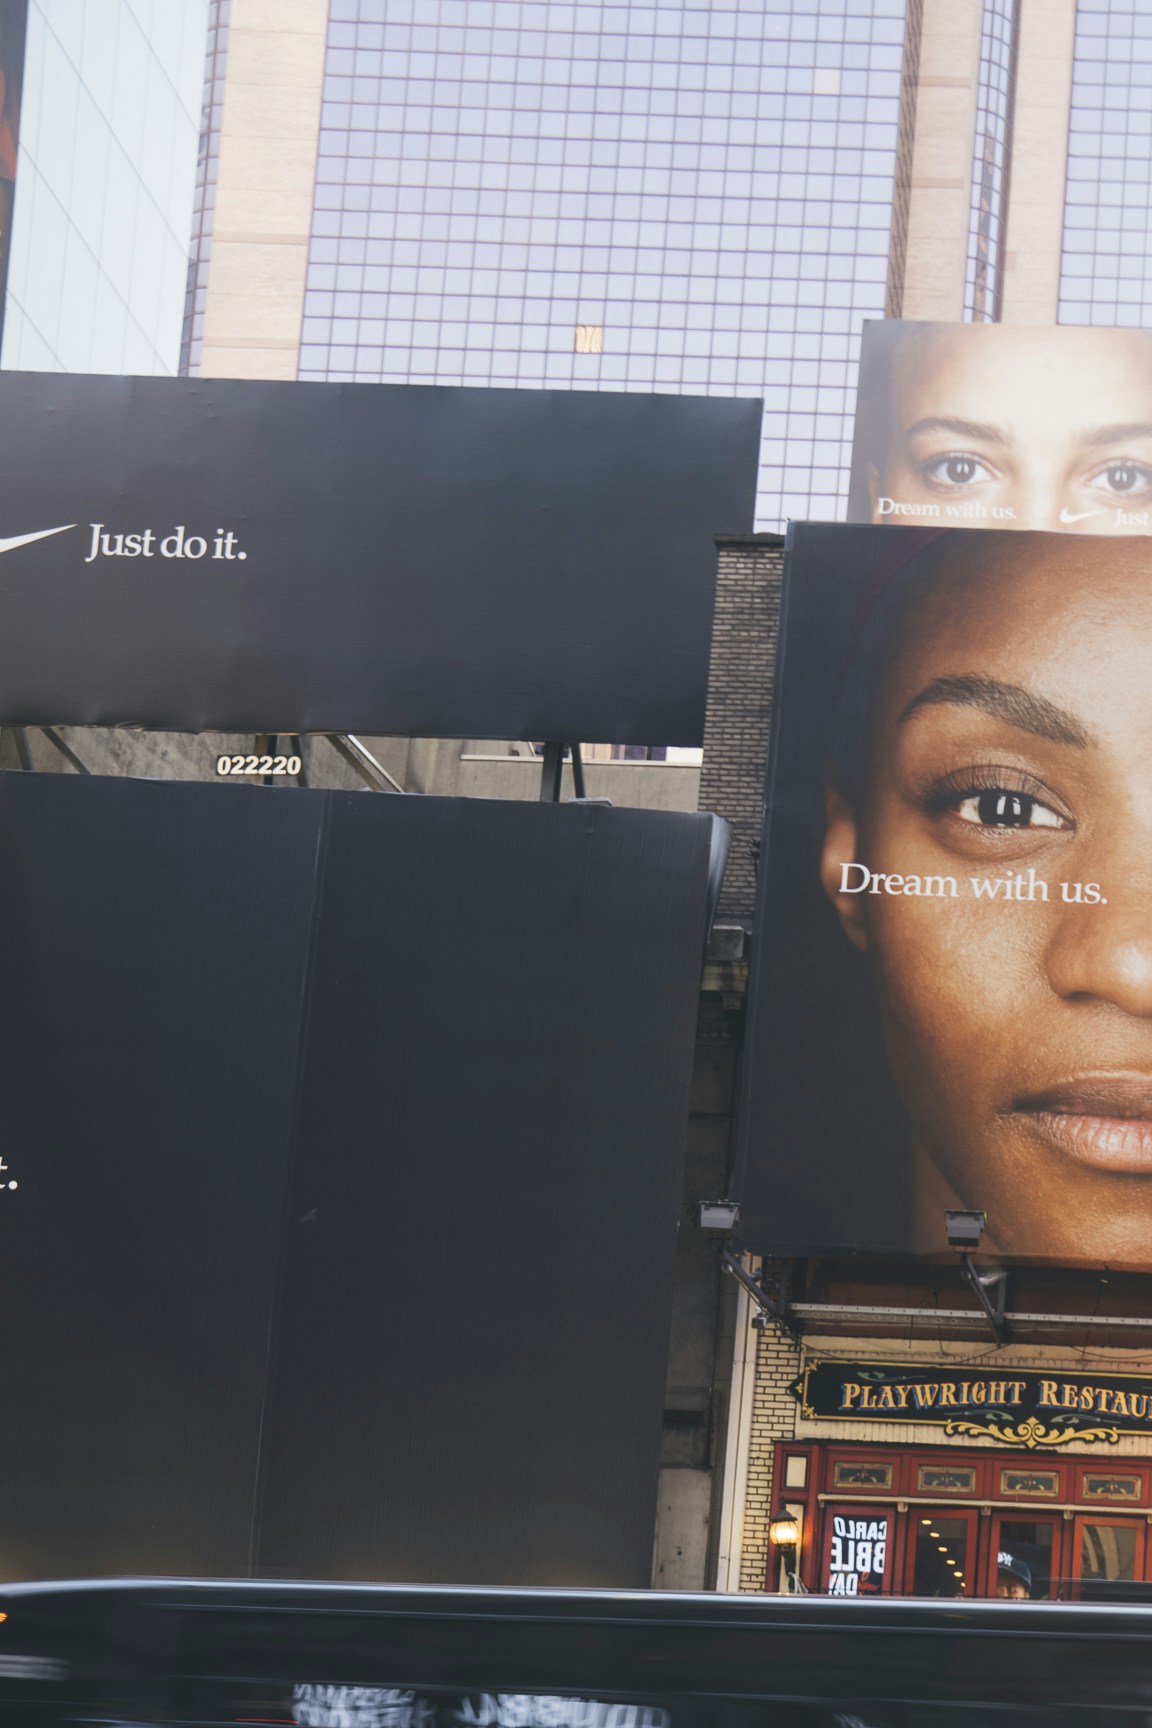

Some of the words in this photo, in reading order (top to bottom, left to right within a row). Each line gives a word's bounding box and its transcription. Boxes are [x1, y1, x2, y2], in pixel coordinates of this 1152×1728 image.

[877, 497, 940, 518] Dream
[945, 500, 987, 519] with
[991, 506, 1018, 521] us.
[1114, 508, 1151, 528] Just
[85, 523, 155, 563] Just
[160, 526, 207, 560] do
[211, 528, 248, 561] it.
[217, 755, 302, 775] 022220
[838, 863, 959, 899] Dream
[968, 866, 1049, 903] with
[1060, 878, 1108, 906] us.
[841, 1381, 1027, 1410] PLAYWRIGHT
